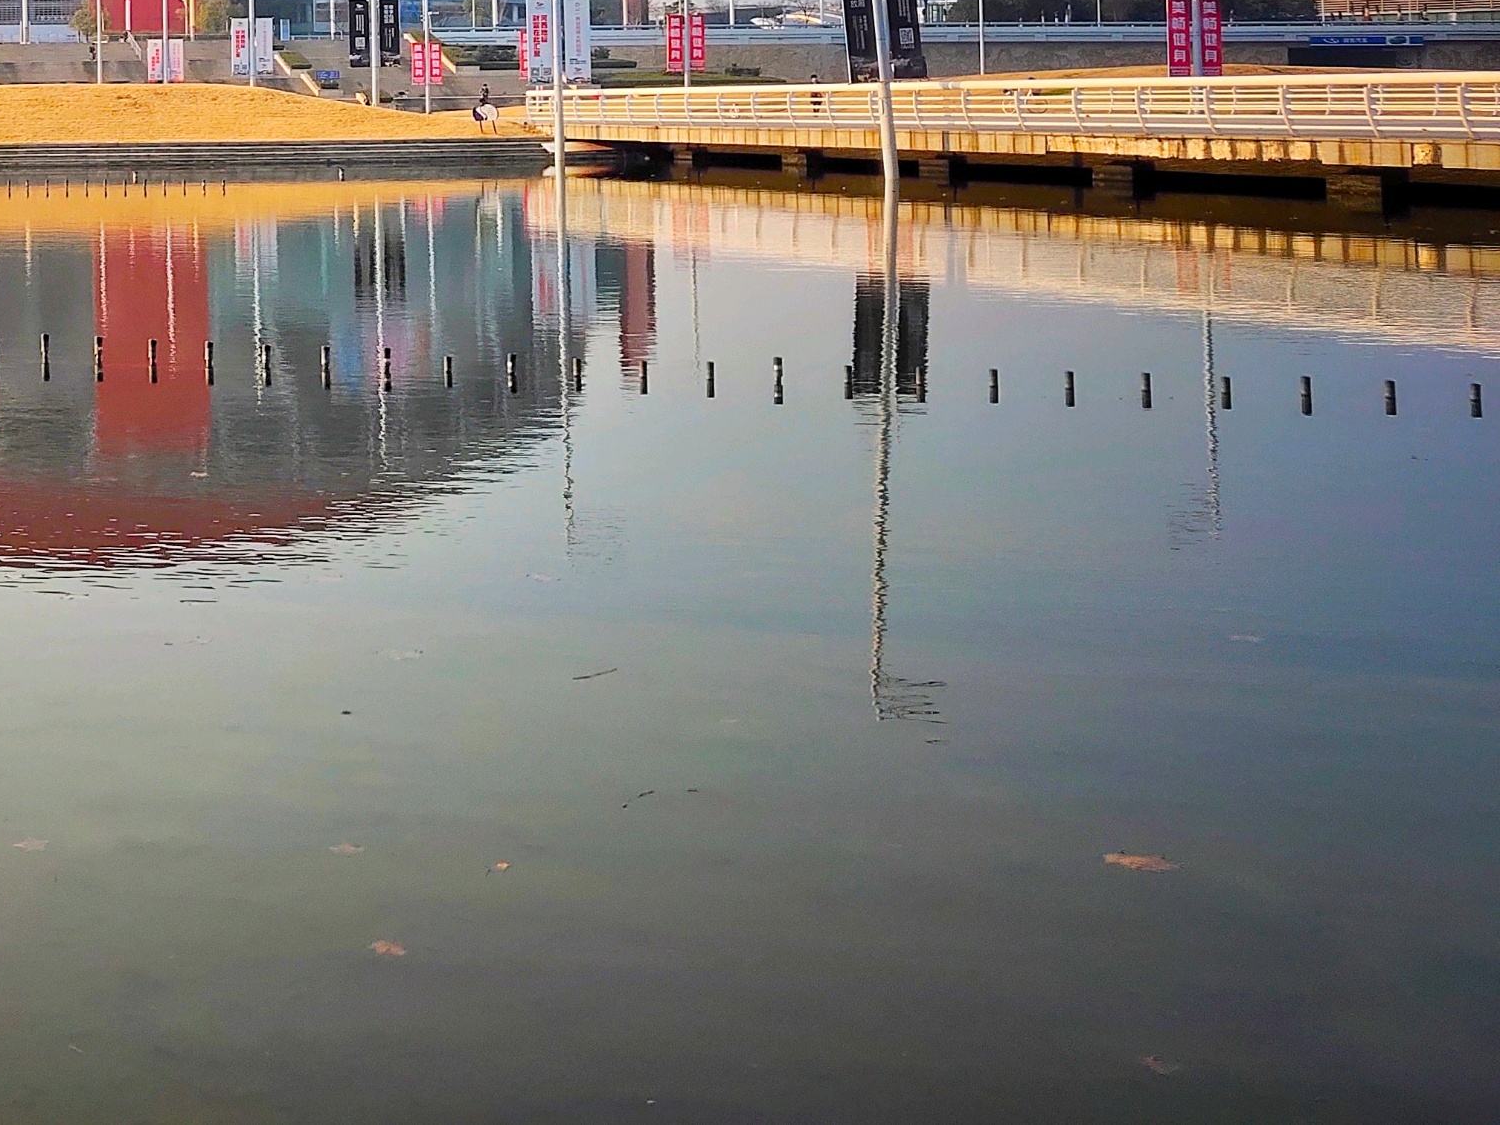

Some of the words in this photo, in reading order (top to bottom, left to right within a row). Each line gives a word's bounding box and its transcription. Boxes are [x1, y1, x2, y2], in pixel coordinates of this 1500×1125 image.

[1172, 1, 1186, 62] 美畅健身
[1203, 1, 1217, 62] 美畅健身
